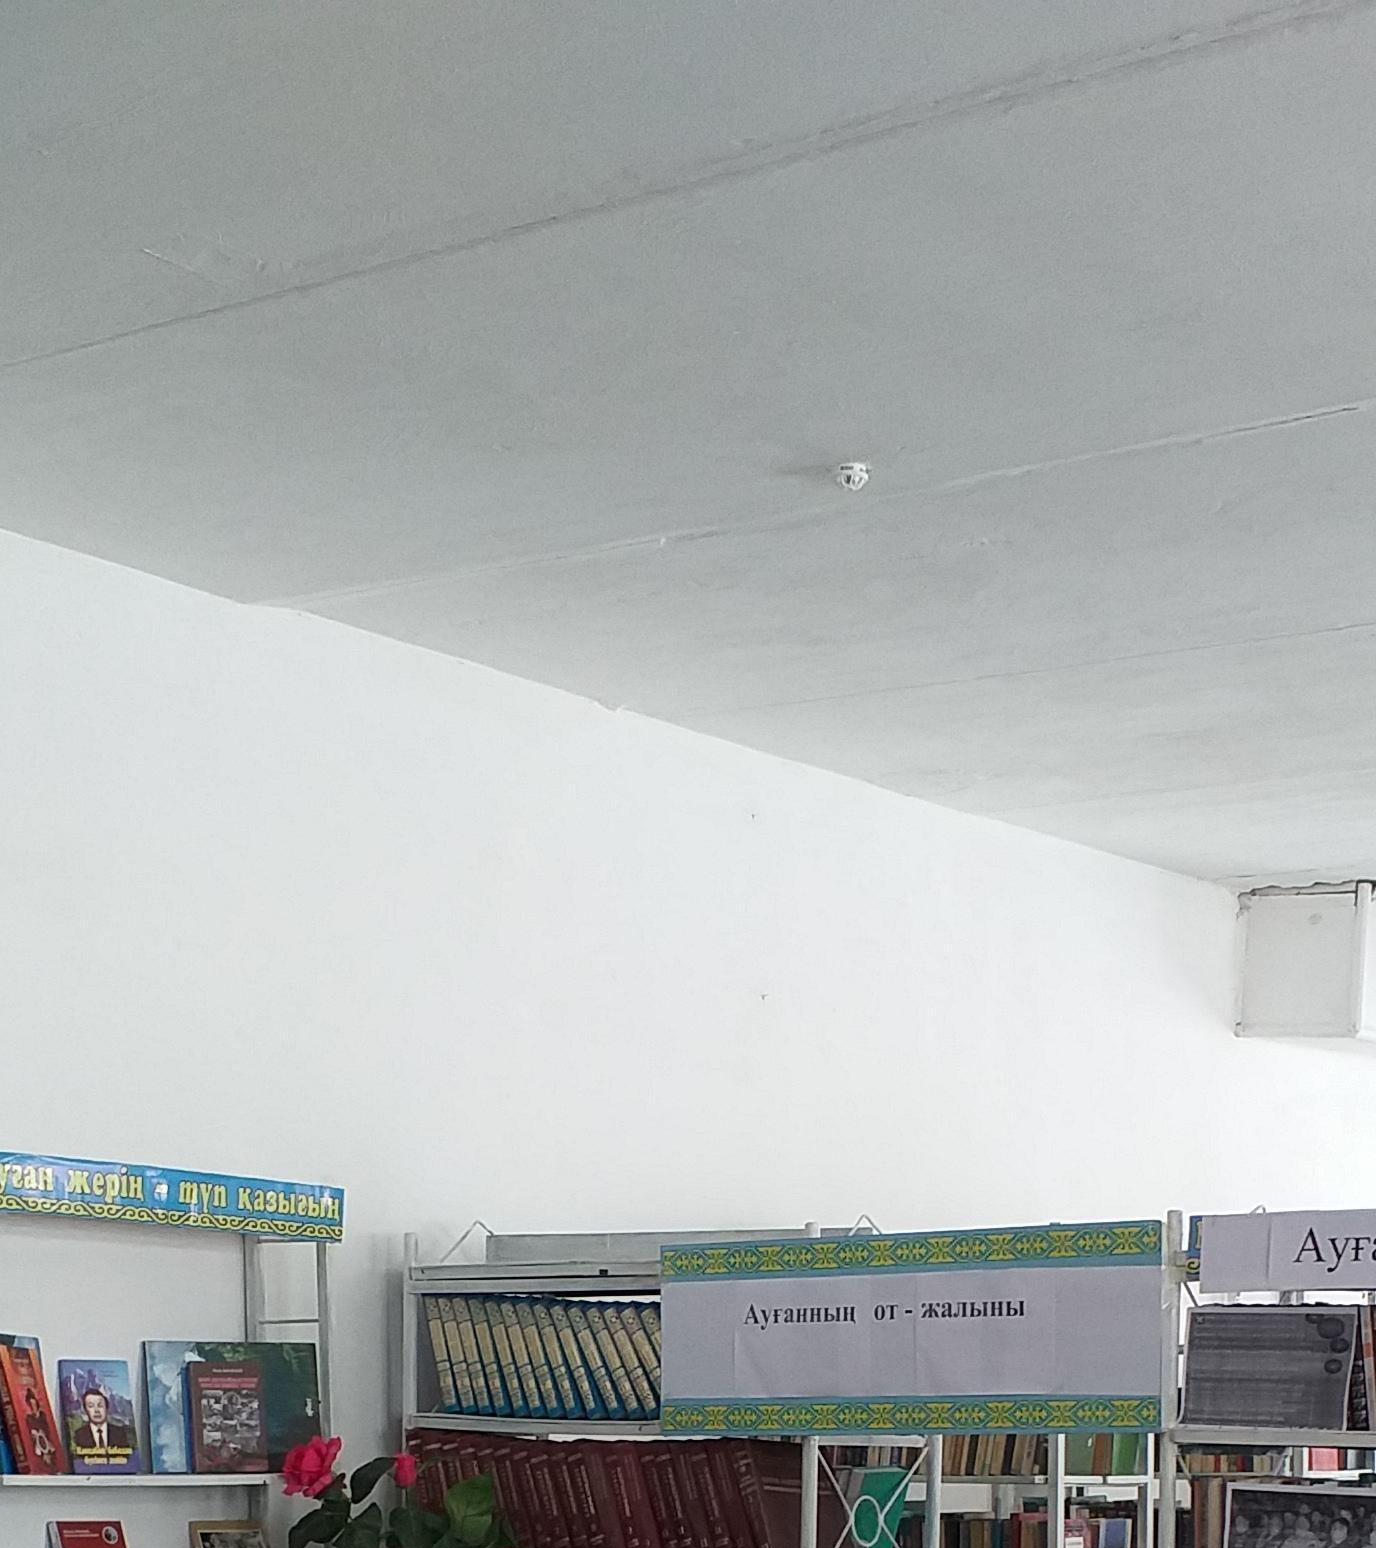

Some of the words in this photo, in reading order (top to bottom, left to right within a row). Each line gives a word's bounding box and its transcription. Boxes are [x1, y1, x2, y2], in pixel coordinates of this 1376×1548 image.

[66, 1167, 144, 1204] жерің
[179, 1180, 228, 1214] түп
[744, 1303, 856, 1330] Ауғанның
[874, 1303, 898, 1321] от
[921, 1300, 1025, 1319] жалыны
